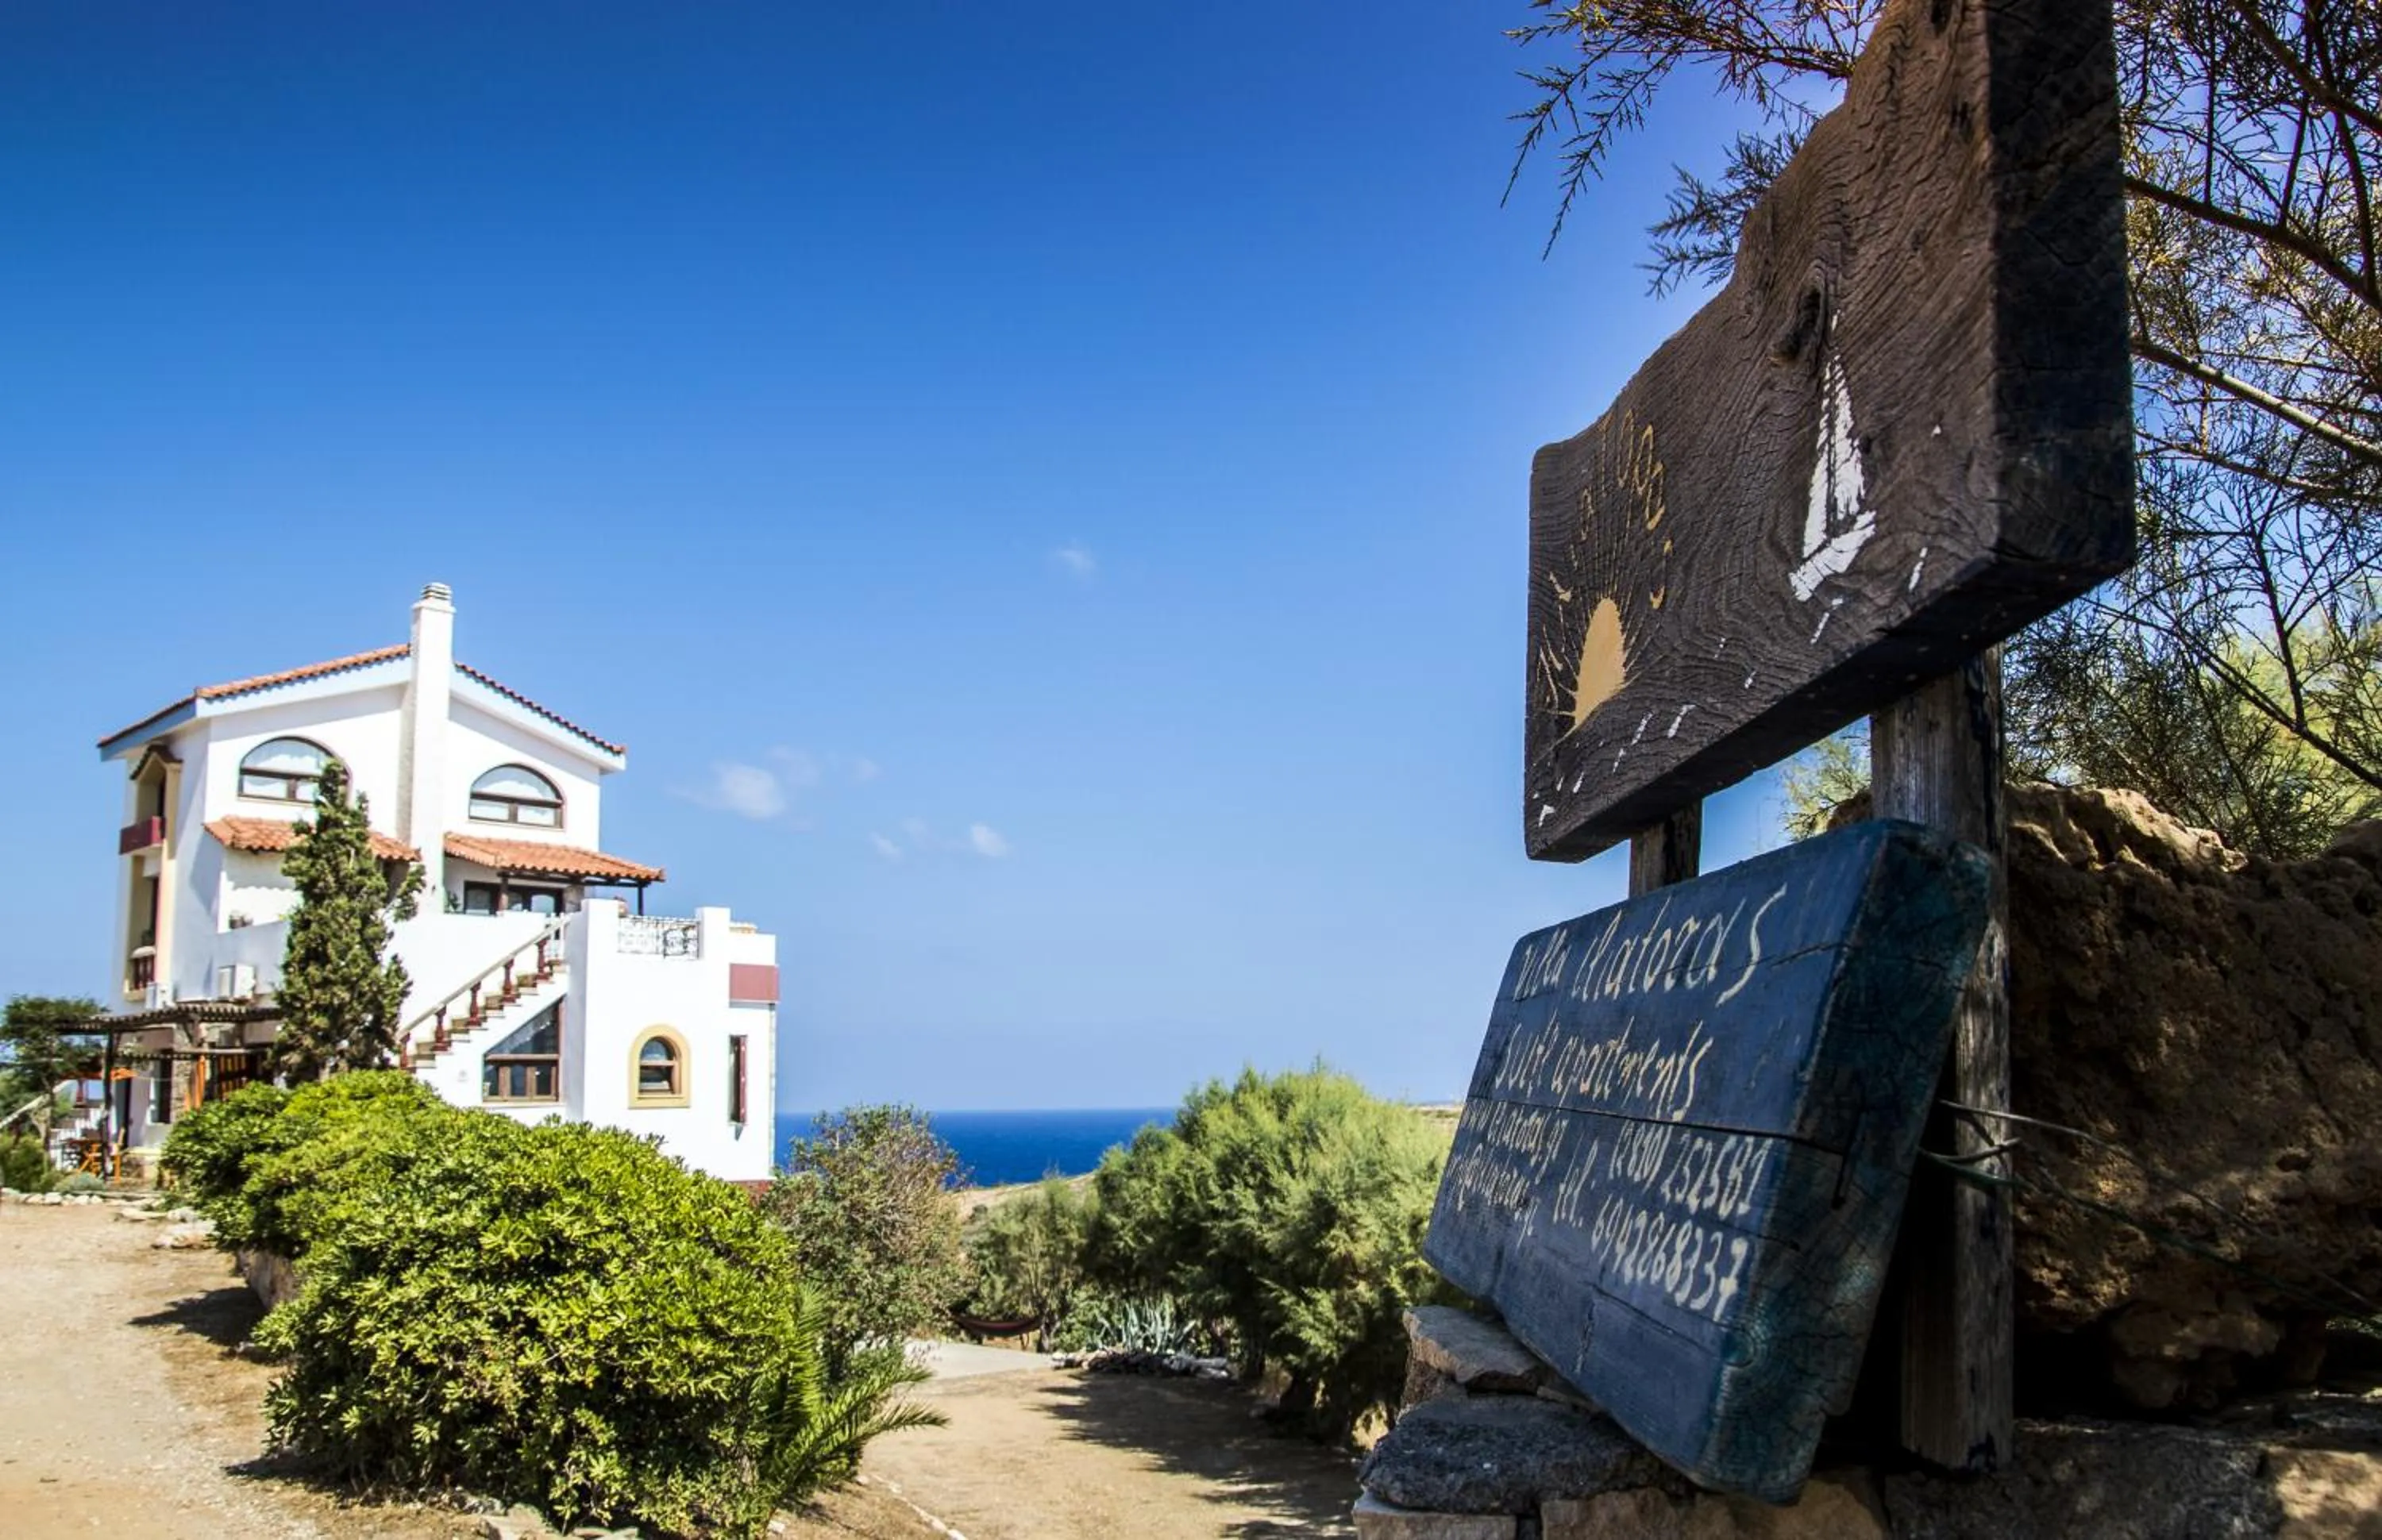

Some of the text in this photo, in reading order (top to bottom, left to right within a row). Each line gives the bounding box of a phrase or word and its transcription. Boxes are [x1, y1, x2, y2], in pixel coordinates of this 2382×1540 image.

[1551, 1015, 1713, 1122] apartments
[1460, 1099, 1570, 1185] wwwiliatoras.gr
[1608, 1118, 1674, 1194] (2810)
[1660, 1132, 1774, 1221] 252581
[1590, 1192, 1748, 1322] 6942868337
